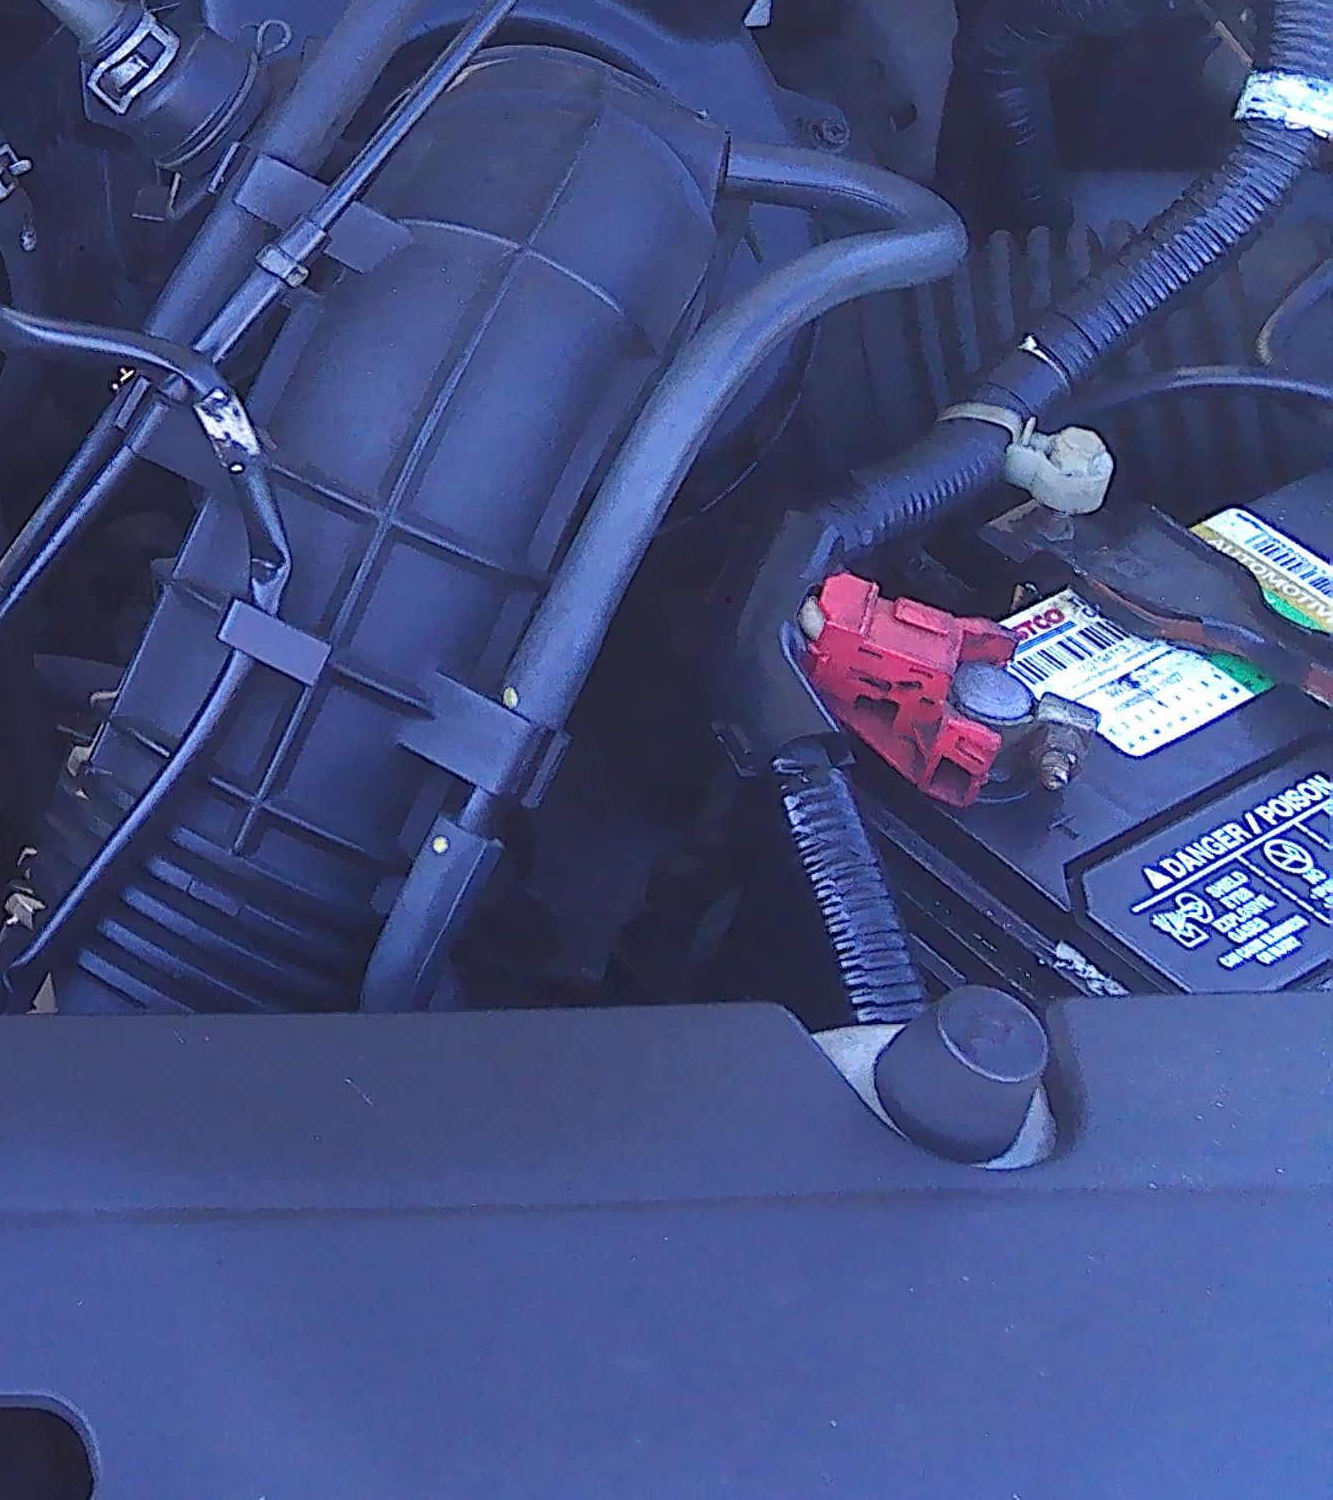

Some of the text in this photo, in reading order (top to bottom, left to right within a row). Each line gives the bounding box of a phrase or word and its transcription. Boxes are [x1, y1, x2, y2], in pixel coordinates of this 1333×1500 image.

[1013, 607, 1066, 642] STCO
[1159, 822, 1253, 879] DANGER
[1254, 774, 1333, 826] POISON
